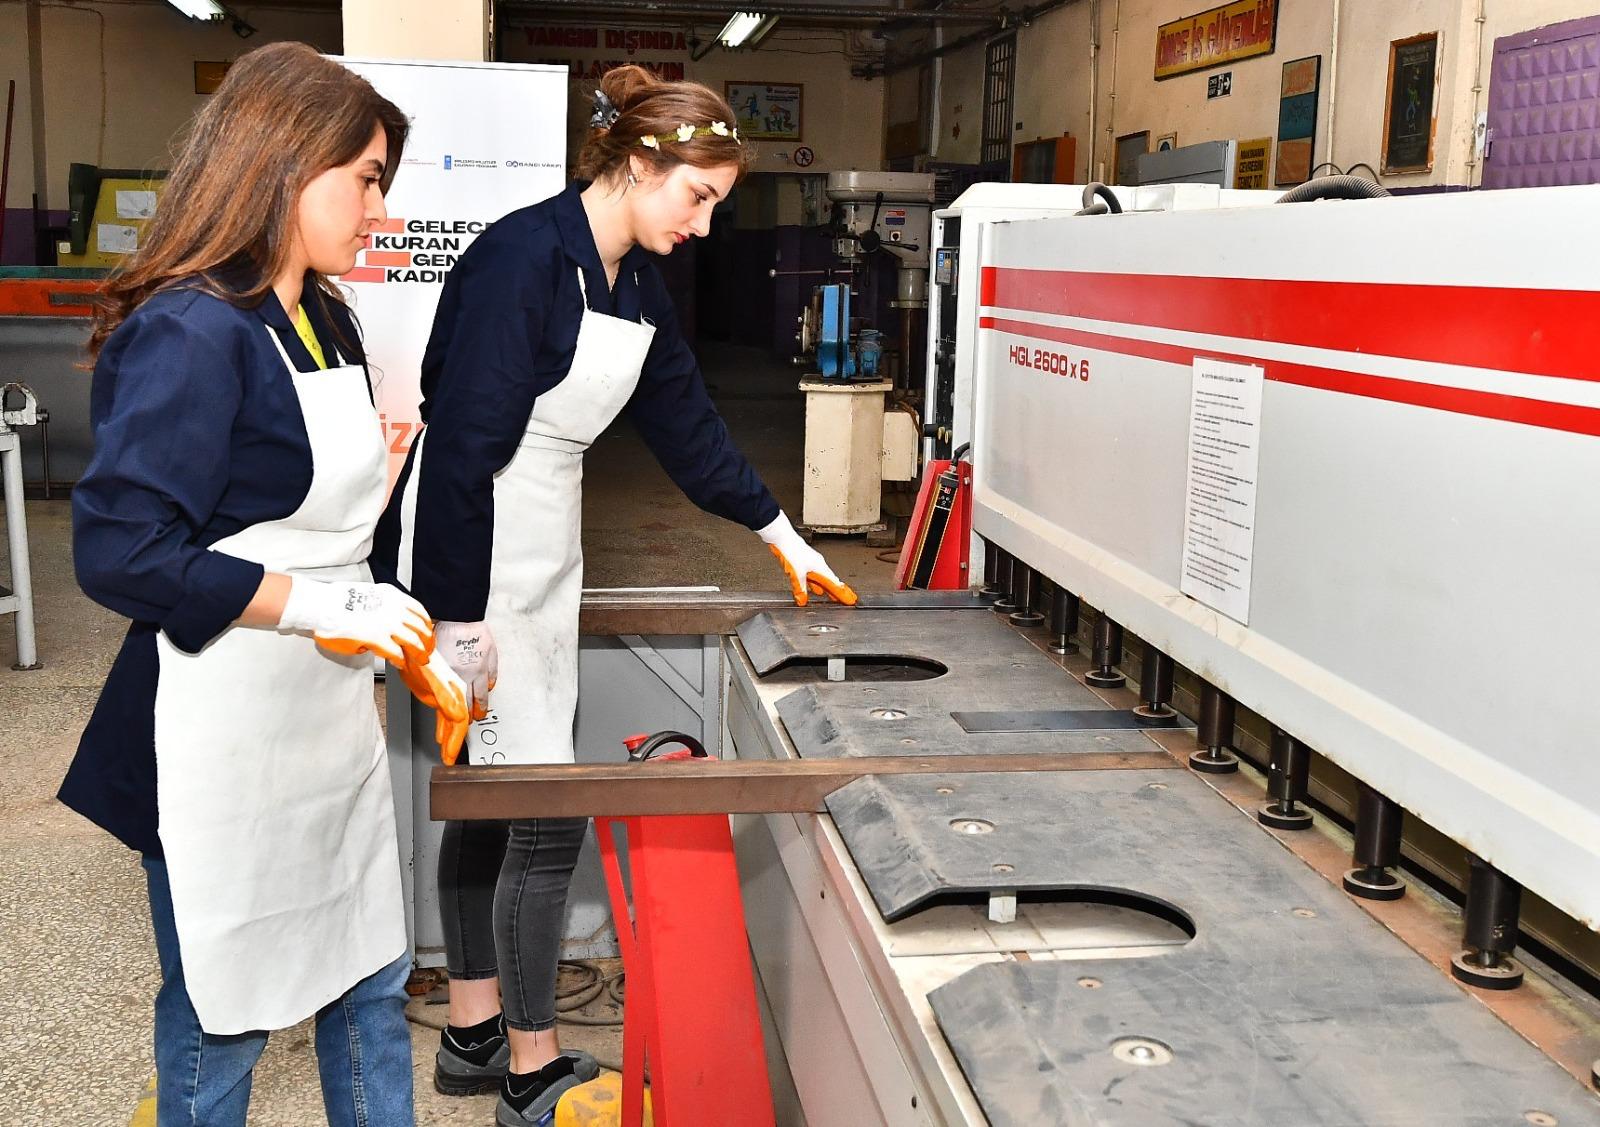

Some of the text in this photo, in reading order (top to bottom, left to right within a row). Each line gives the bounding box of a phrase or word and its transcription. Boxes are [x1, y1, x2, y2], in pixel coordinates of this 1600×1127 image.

[375, 236, 459, 250] KURAN
[1010, 345, 1032, 367] HGL
[1034, 349, 1068, 376] 2600
[1080, 359, 1089, 382] 6
